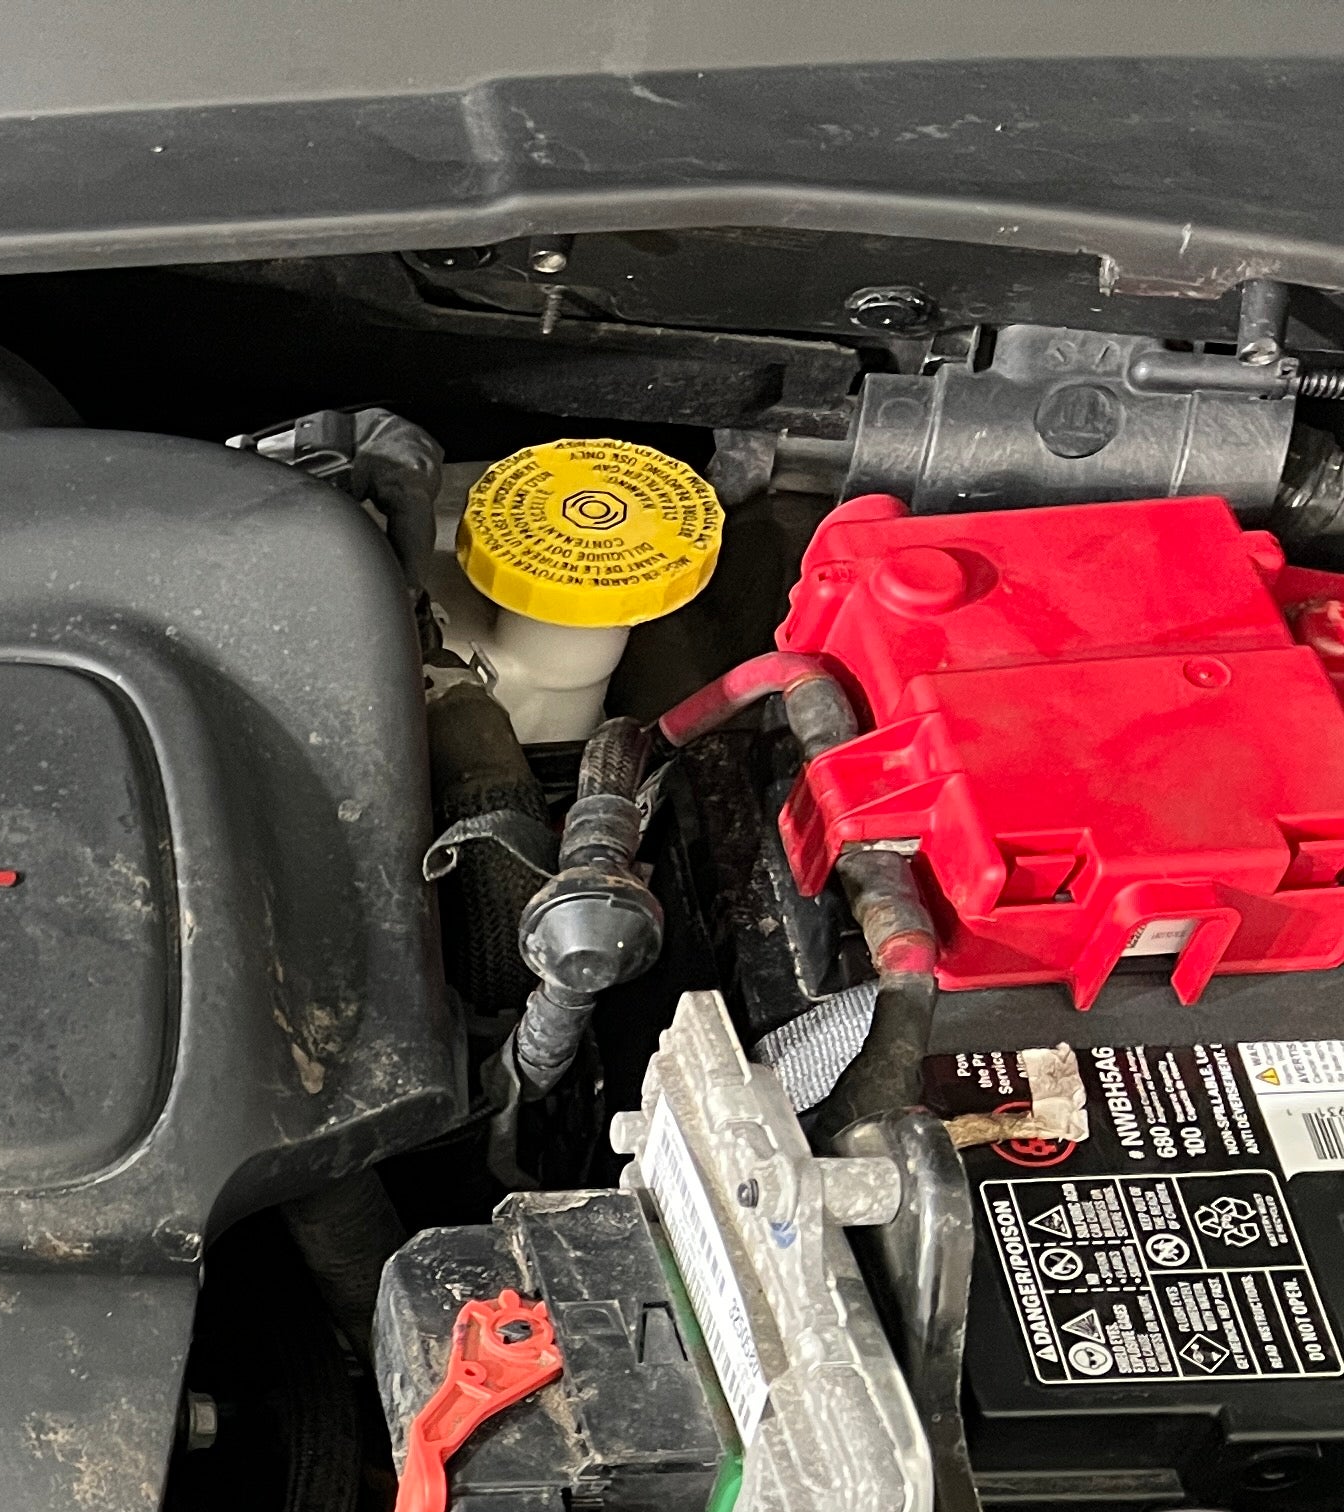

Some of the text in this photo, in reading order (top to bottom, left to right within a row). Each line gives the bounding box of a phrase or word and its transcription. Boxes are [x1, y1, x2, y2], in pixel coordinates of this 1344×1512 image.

[571, 451, 605, 460] ONLY
[613, 453, 638, 467] USE
[538, 524, 624, 549] CONTENANT
[544, 544, 572, 558] DOT
[513, 559, 584, 585] NETTOYER
[978, 1069, 992, 1088] the
[1149, 1126, 1178, 1158] 680
[1180, 1127, 1206, 1157] 100
[993, 1201, 1052, 1345] DANGER/POISON
[1295, 1316, 1318, 1342] NOT
[1305, 1344, 1326, 1361] DO
